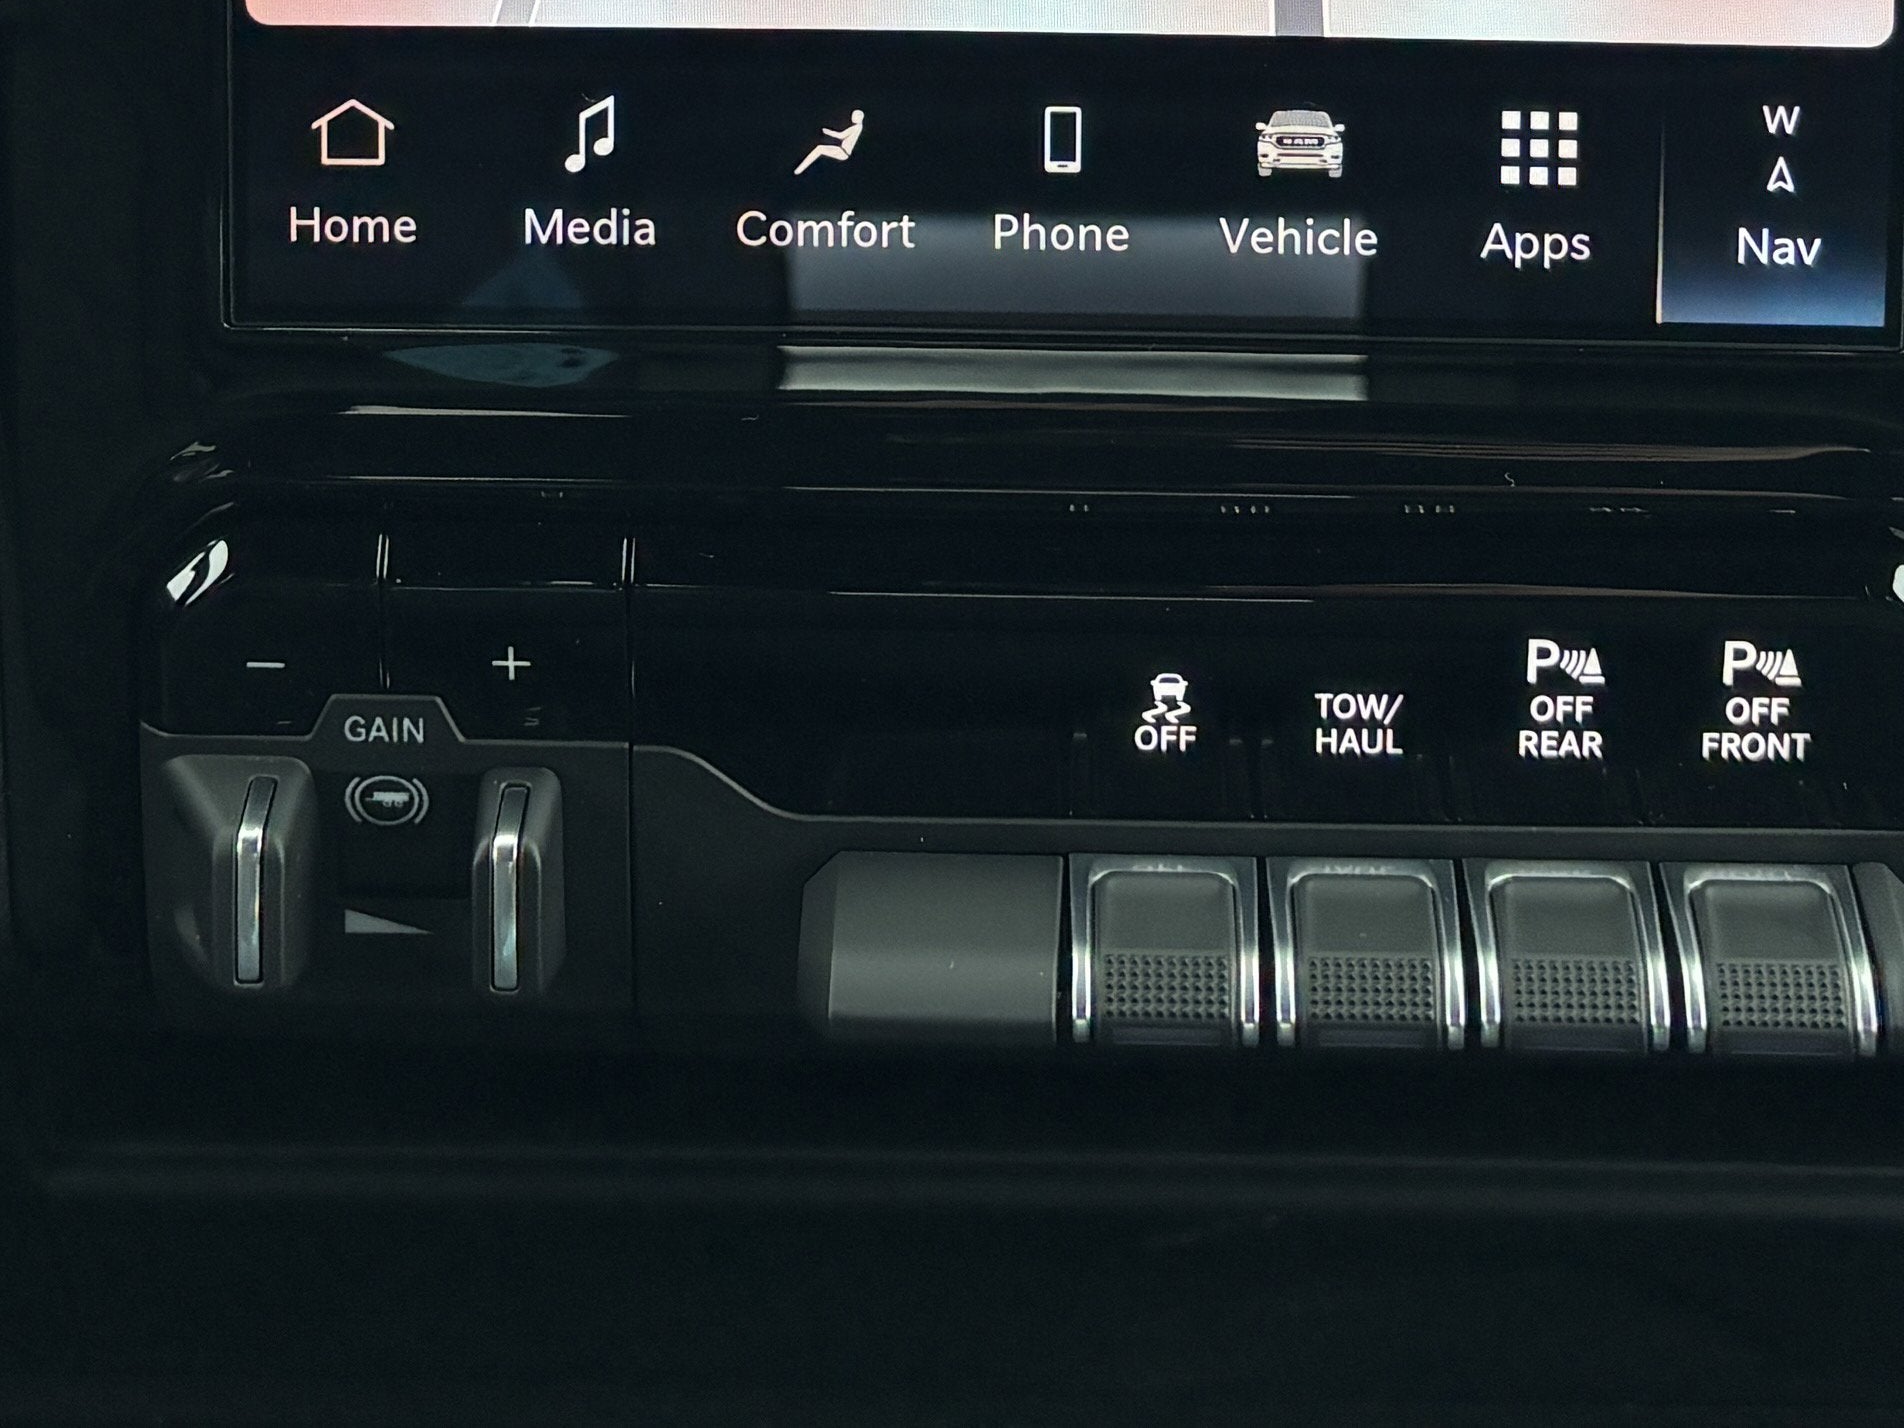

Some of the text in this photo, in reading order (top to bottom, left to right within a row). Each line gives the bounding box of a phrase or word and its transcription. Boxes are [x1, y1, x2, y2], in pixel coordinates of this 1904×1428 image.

[1763, 105, 1800, 134] W
[290, 208, 418, 243] Home
[524, 209, 657, 246] Media
[736, 211, 916, 249] Comfort
[994, 215, 1130, 252] Phone
[1219, 218, 1378, 257] Vehicle
[1480, 223, 1591, 269] Apps
[1737, 229, 1822, 265] Nav
[1315, 693, 1403, 724] TOW/
[1530, 696, 1594, 724] OFF
[1725, 697, 1790, 727] OFF
[344, 715, 425, 743] GAIN
[1134, 725, 1198, 753] OFF
[1315, 727, 1403, 756] HAUL
[1519, 729, 1602, 760] REAR
[1701, 732, 1812, 762] FRONT
